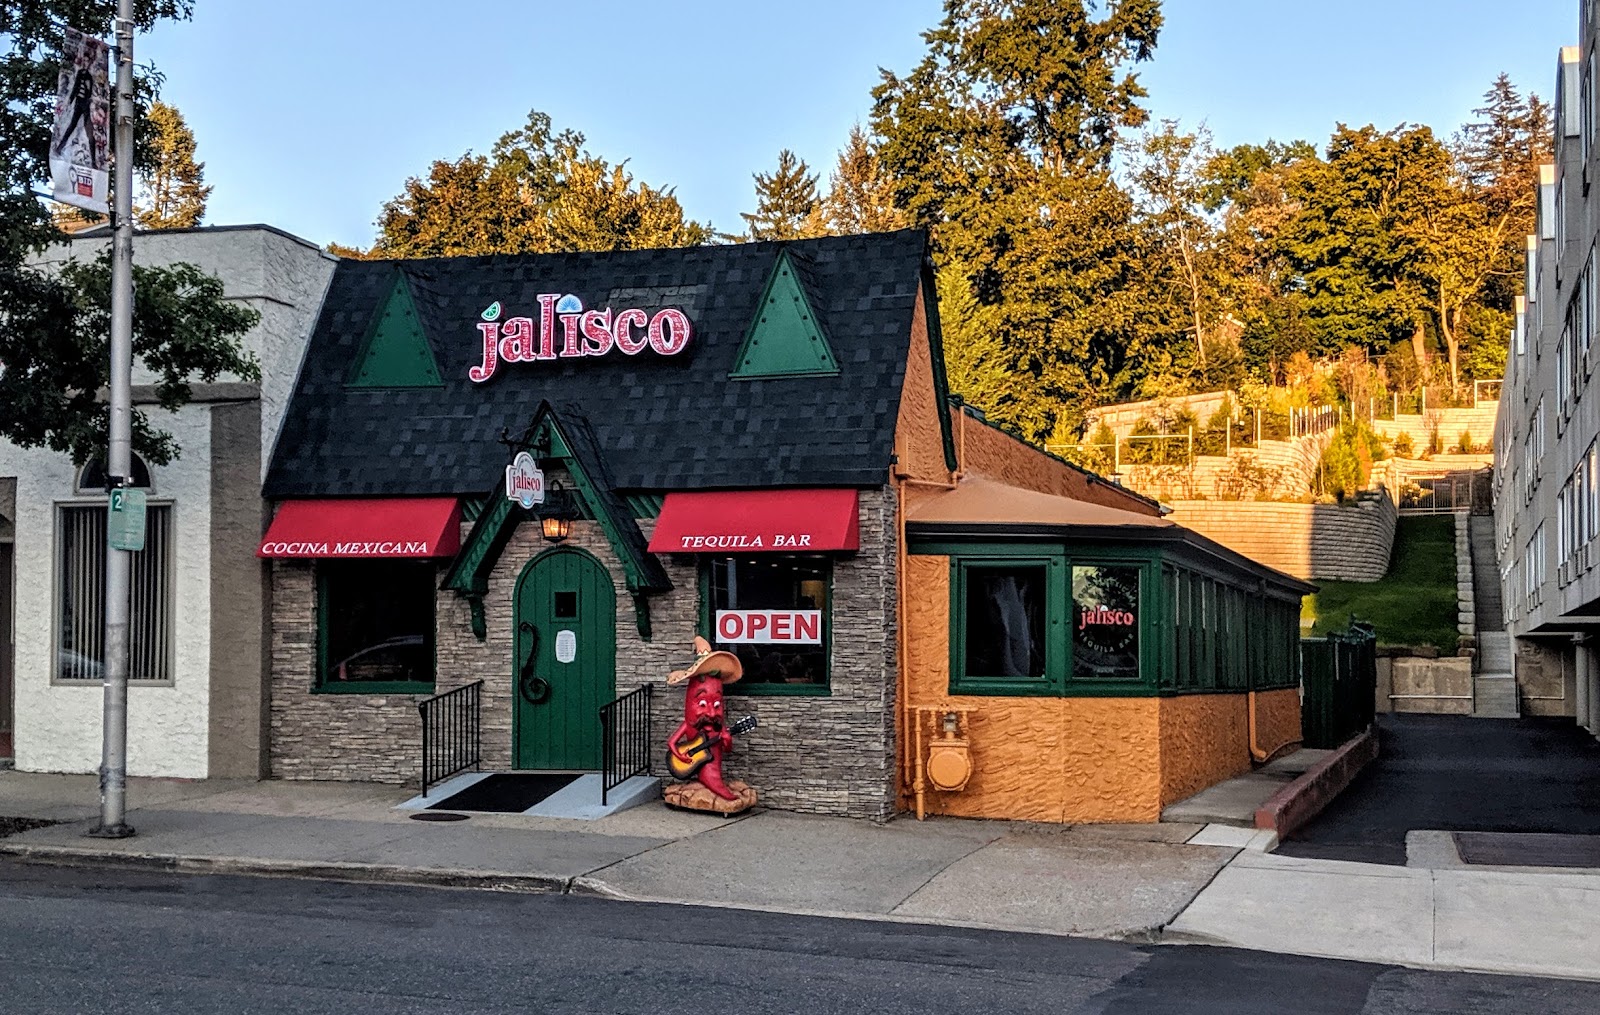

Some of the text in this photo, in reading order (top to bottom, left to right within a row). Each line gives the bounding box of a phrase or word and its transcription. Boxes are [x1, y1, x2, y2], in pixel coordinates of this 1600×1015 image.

[78, 176, 92, 186] BID
[469, 294, 691, 383] jalisco
[511, 468, 541, 496] jalisco
[114, 495, 122, 509] 2
[262, 541, 427, 554] COCINA MEXICANA
[681, 534, 811, 548] TEQUILA BAR
[1079, 604, 1134, 630] jalisco
[718, 613, 819, 640] OPEN
[1118, 633, 1134, 649] BAR
